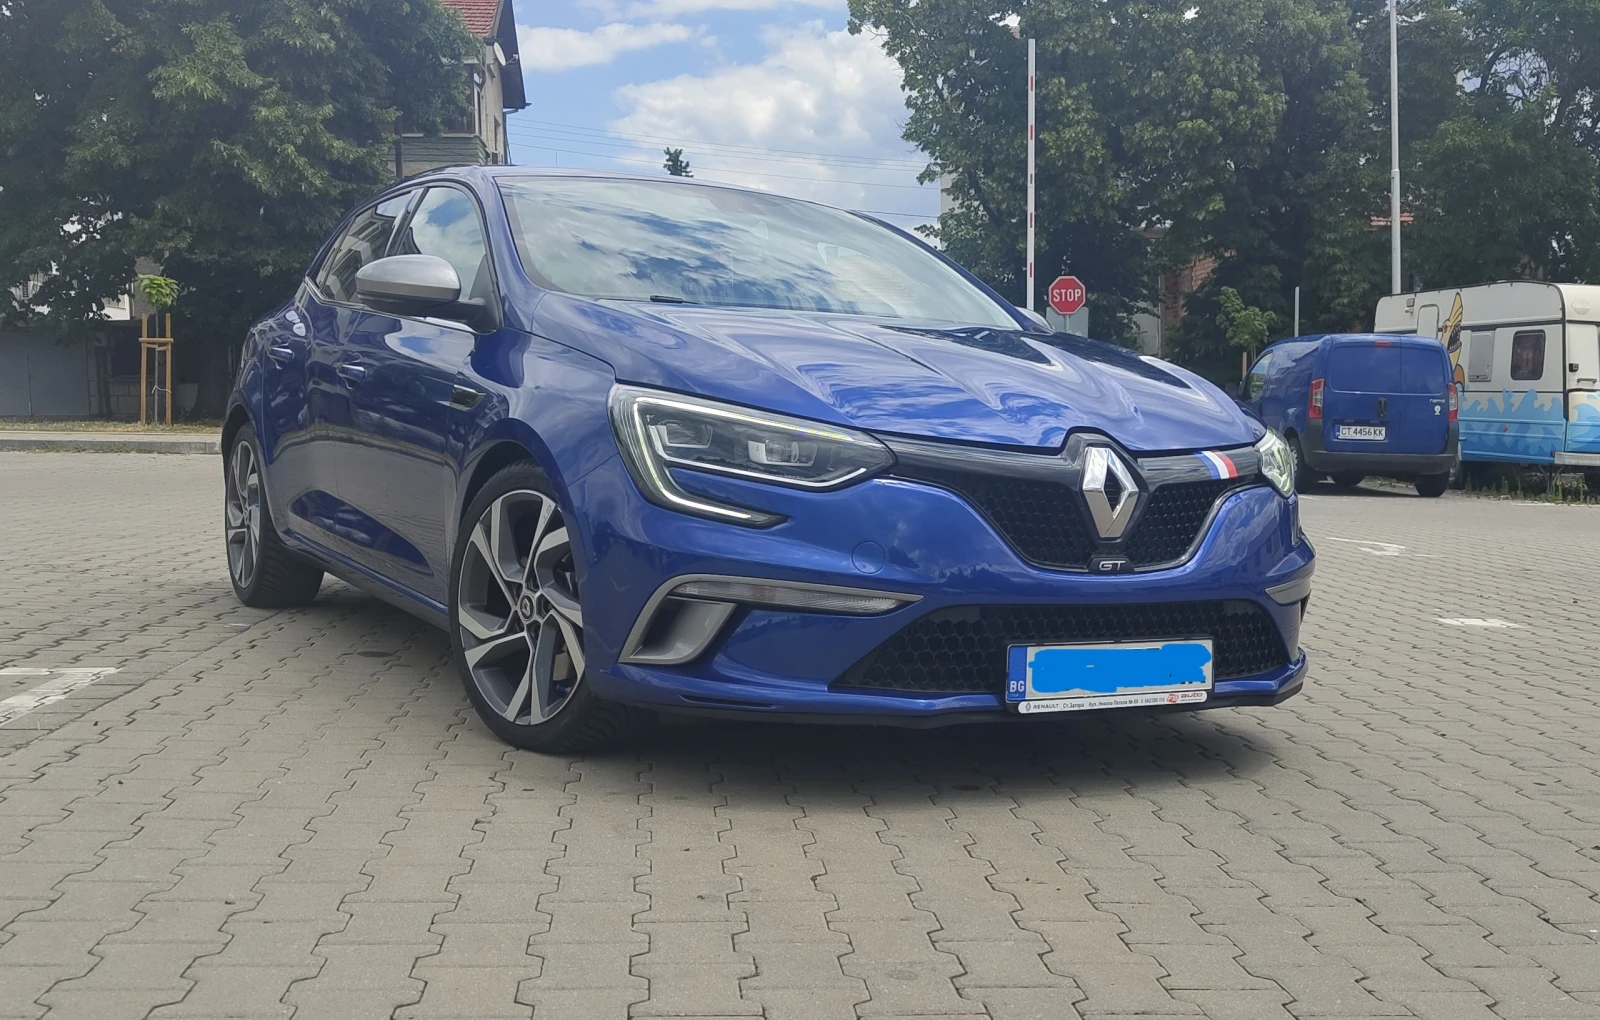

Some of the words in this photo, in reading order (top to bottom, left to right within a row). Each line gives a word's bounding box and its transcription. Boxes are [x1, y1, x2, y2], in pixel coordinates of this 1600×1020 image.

[1053, 289, 1081, 302] STOP
[1341, 427, 1352, 436] CT
[1353, 427, 1372, 436] 4456
[1373, 428, 1384, 437] KK
[1099, 560, 1126, 571] GT
[1009, 680, 1025, 693] BG
